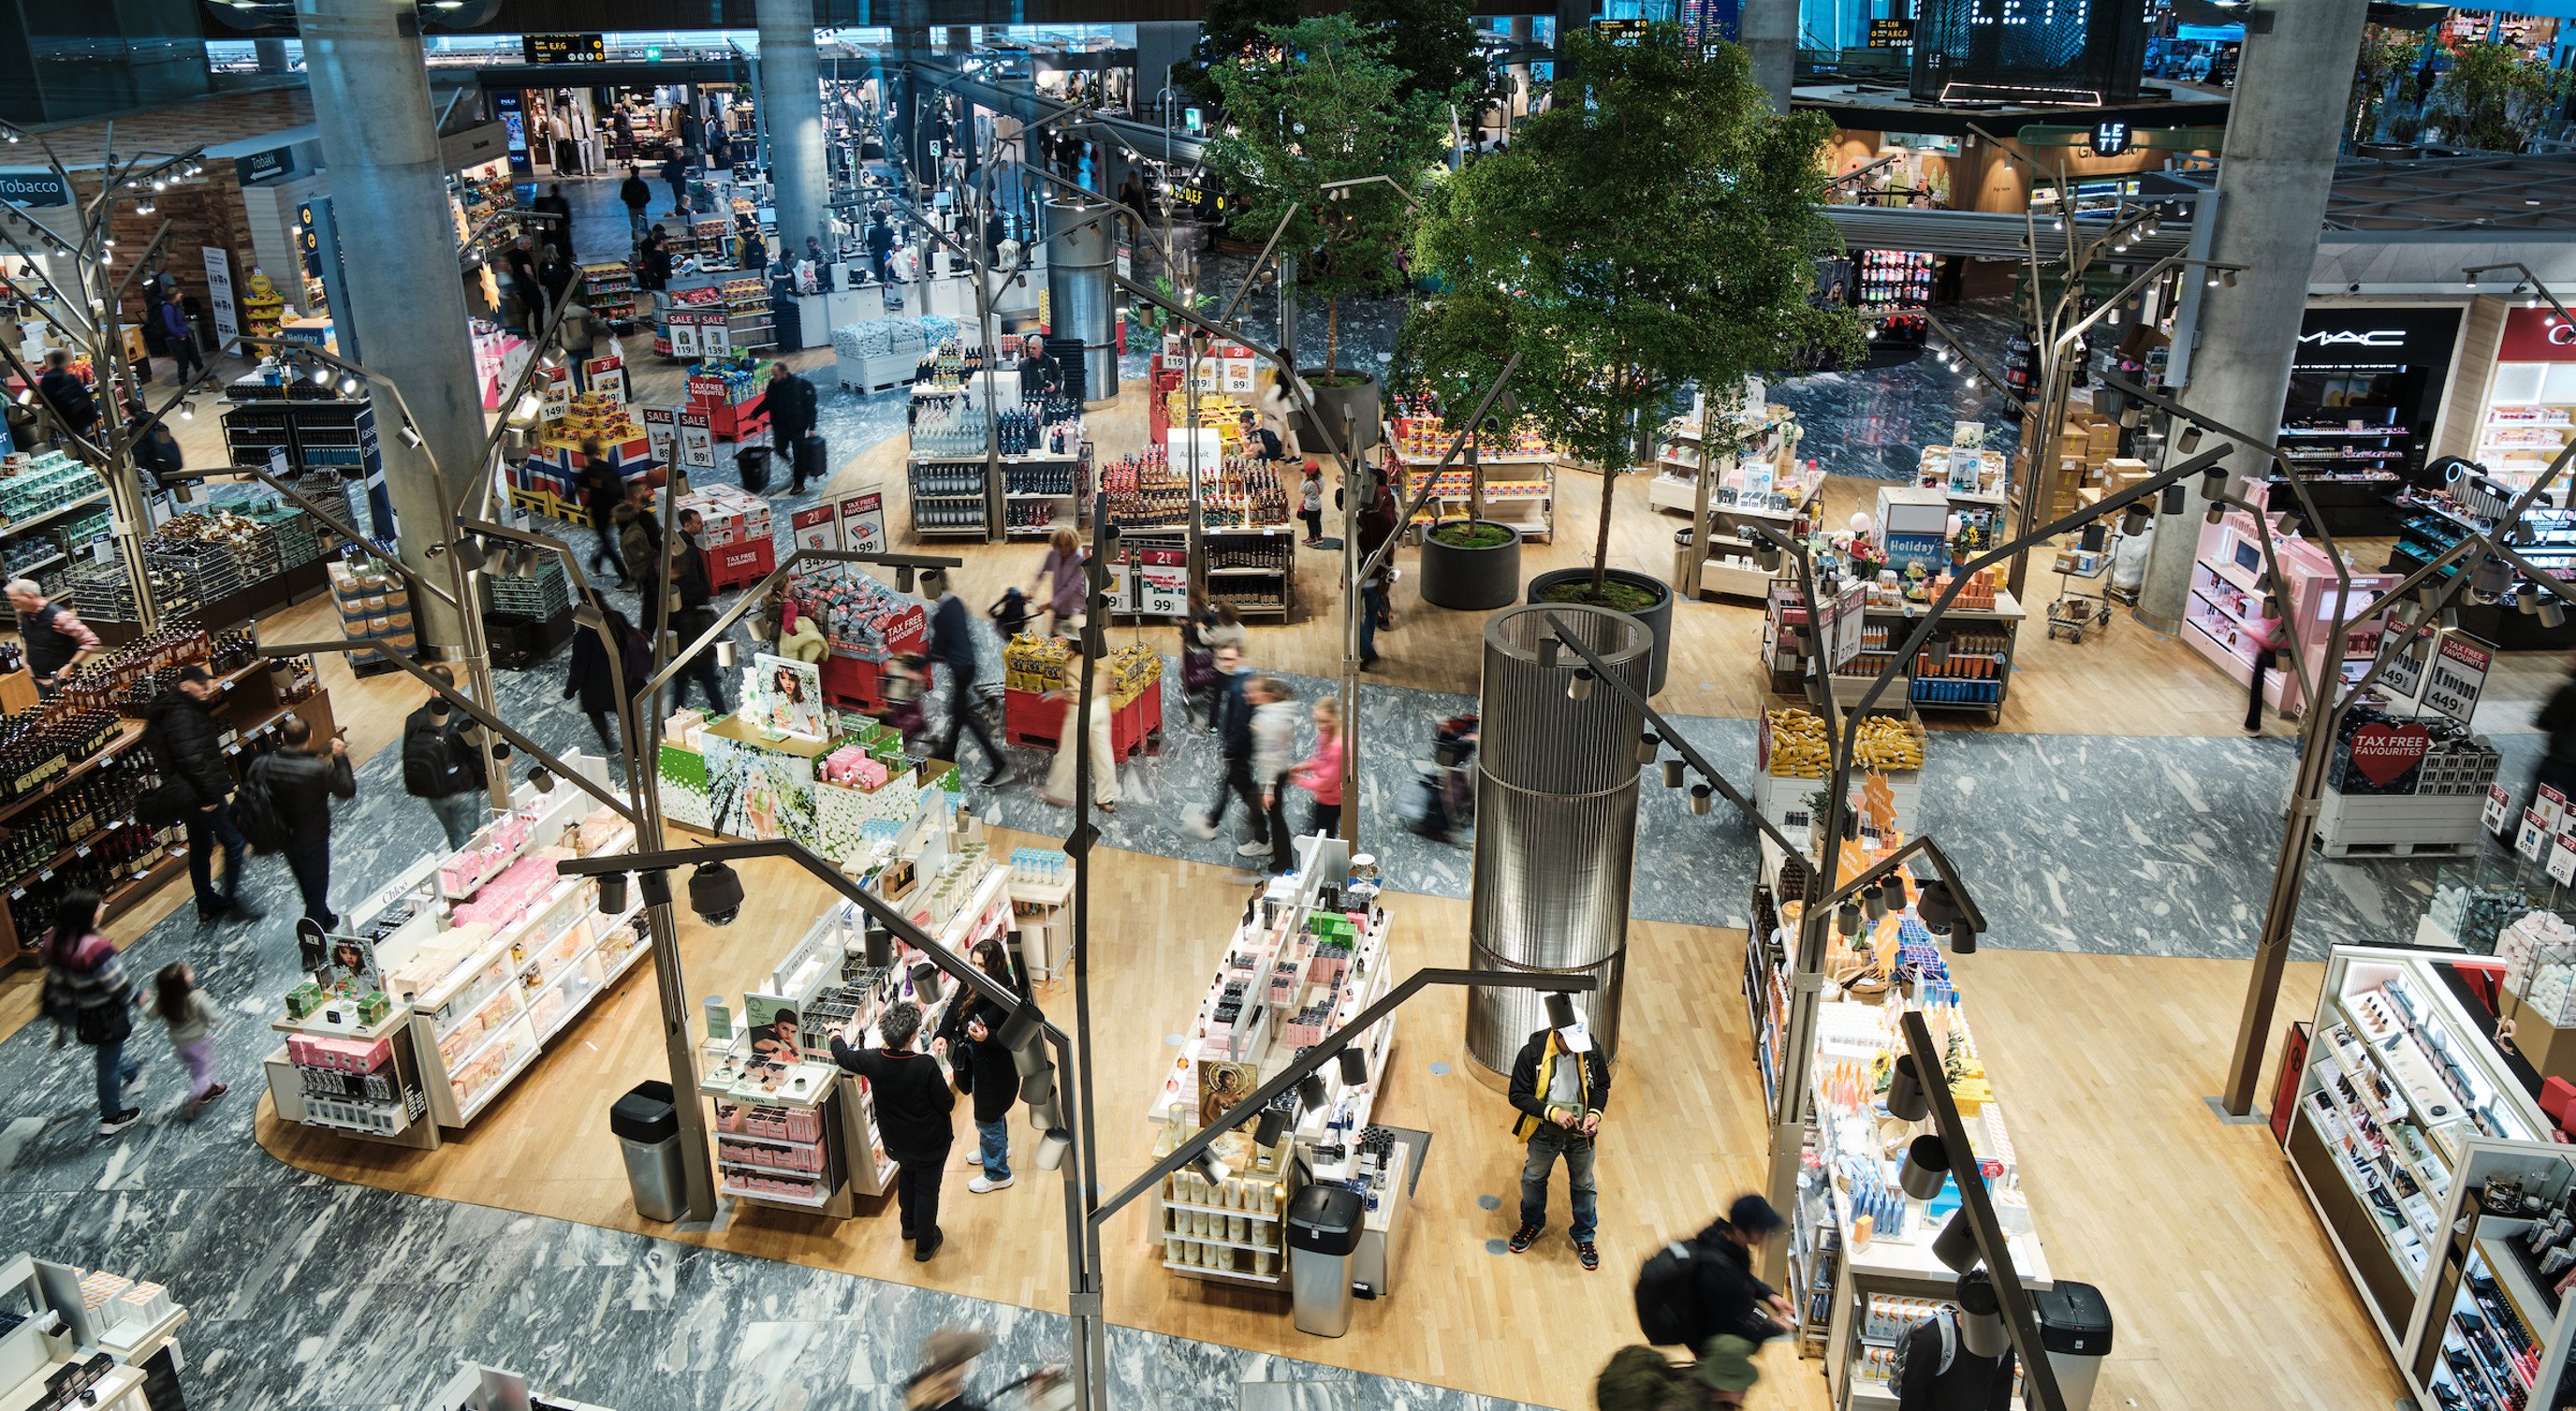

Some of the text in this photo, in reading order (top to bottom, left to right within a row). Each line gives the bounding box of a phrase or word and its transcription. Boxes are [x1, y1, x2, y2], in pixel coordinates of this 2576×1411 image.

[251, 154, 277, 169] Tobakk
[0, 181, 59, 194] Tobacco
[669, 315, 693, 324] SALE
[702, 316, 725, 325] SALE
[708, 346, 724, 355] 139
[1167, 358, 1184, 366] 119
[706, 383, 724, 391] FREE
[545, 405, 562, 417] 149
[647, 412, 671, 422] SALE
[681, 416, 705, 426] SALE
[694, 452, 705, 462] 89
[846, 496, 876, 509] TAX FREE
[843, 502, 879, 517] FAVOURITE
[852, 541, 873, 553] 199
[1890, 539, 1935, 555] Holiday
[1153, 599, 1170, 611] 99
[1844, 591, 1865, 611] SALE
[1818, 609, 1834, 625] ALE
[886, 612, 923, 638] TAX FREE
[888, 623, 924, 645] FAVOURITES
[2448, 639, 2485, 660] TAX FREE
[2442, 646, 2485, 669] FAVOURITE
[2431, 693, 2458, 712] 449
[2356, 735, 2424, 747] TAX FREE
[2354, 746, 2422, 756] FAVOURITES
[382, 879, 408, 904] Chloé
[304, 933, 320, 946] NEW
[403, 1083, 418, 1122] LANDED
[414, 1091, 427, 1114] JUST
[739, 1095, 765, 1104] PRADA
